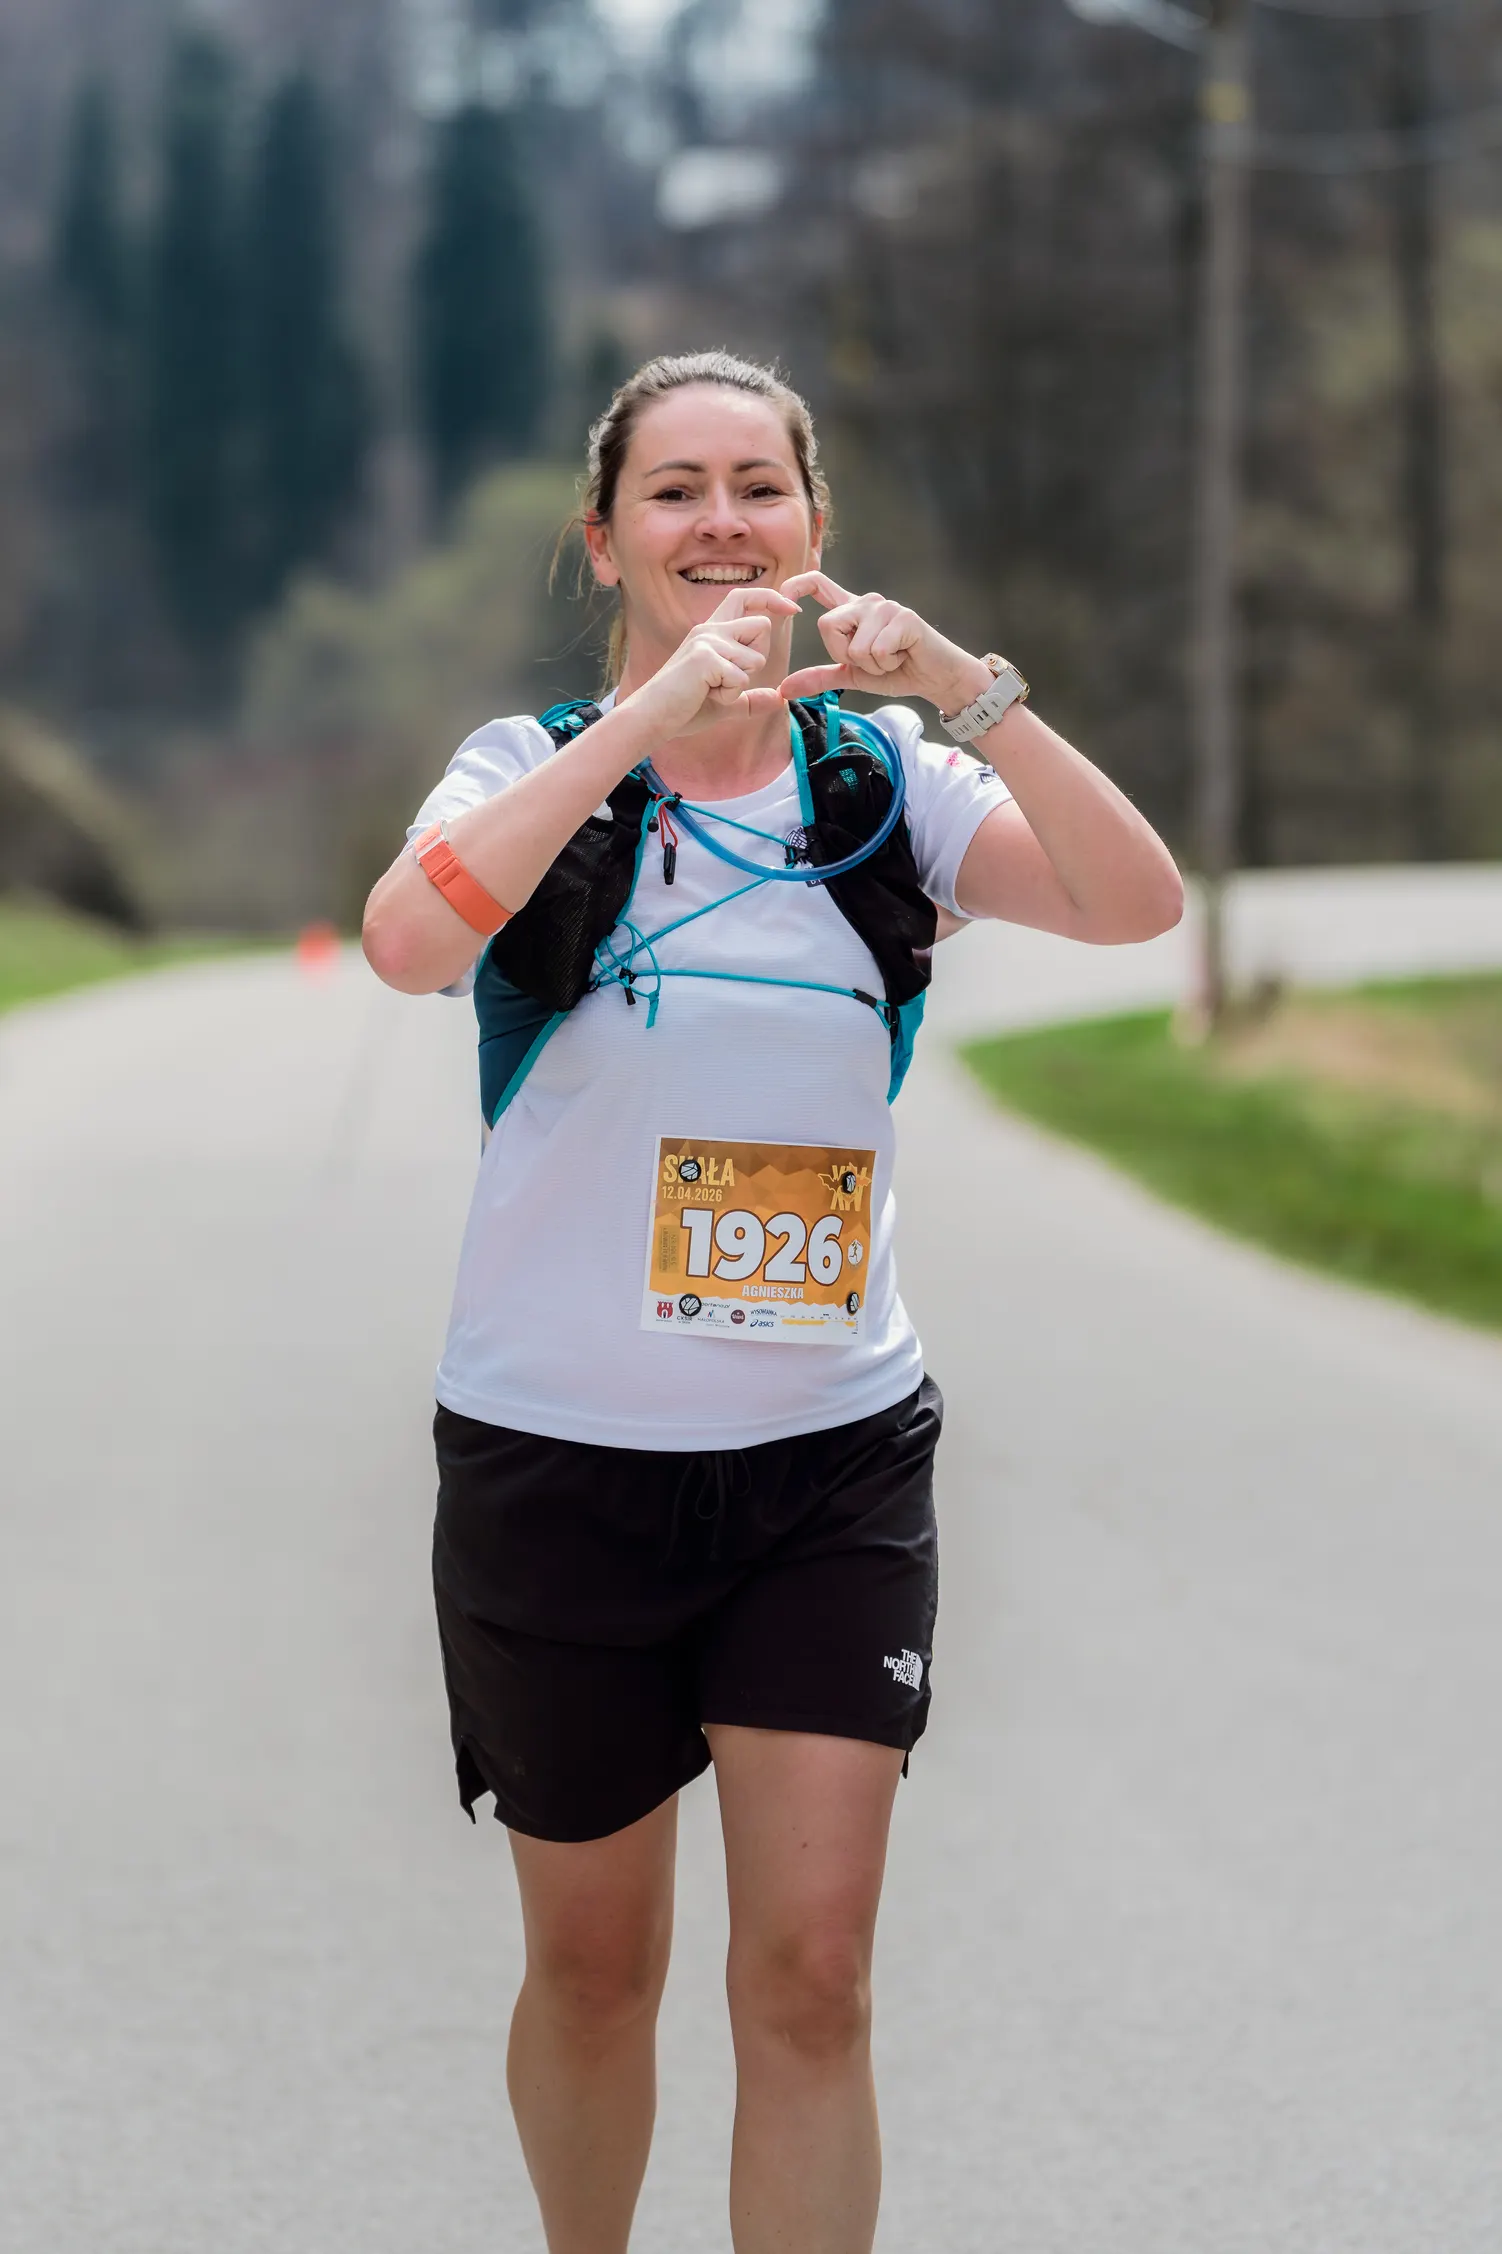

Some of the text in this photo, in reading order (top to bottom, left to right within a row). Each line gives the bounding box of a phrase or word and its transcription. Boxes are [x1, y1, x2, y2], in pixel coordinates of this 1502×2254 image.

[662, 1185, 723, 1202] 12.04.2026
[680, 1207, 844, 1286] 1926
[741, 1284, 804, 1300] AGNIESZKA
[901, 1648, 917, 1664] THE
[883, 1655, 915, 1675] NORTH
[893, 1669, 914, 1686] FACE
